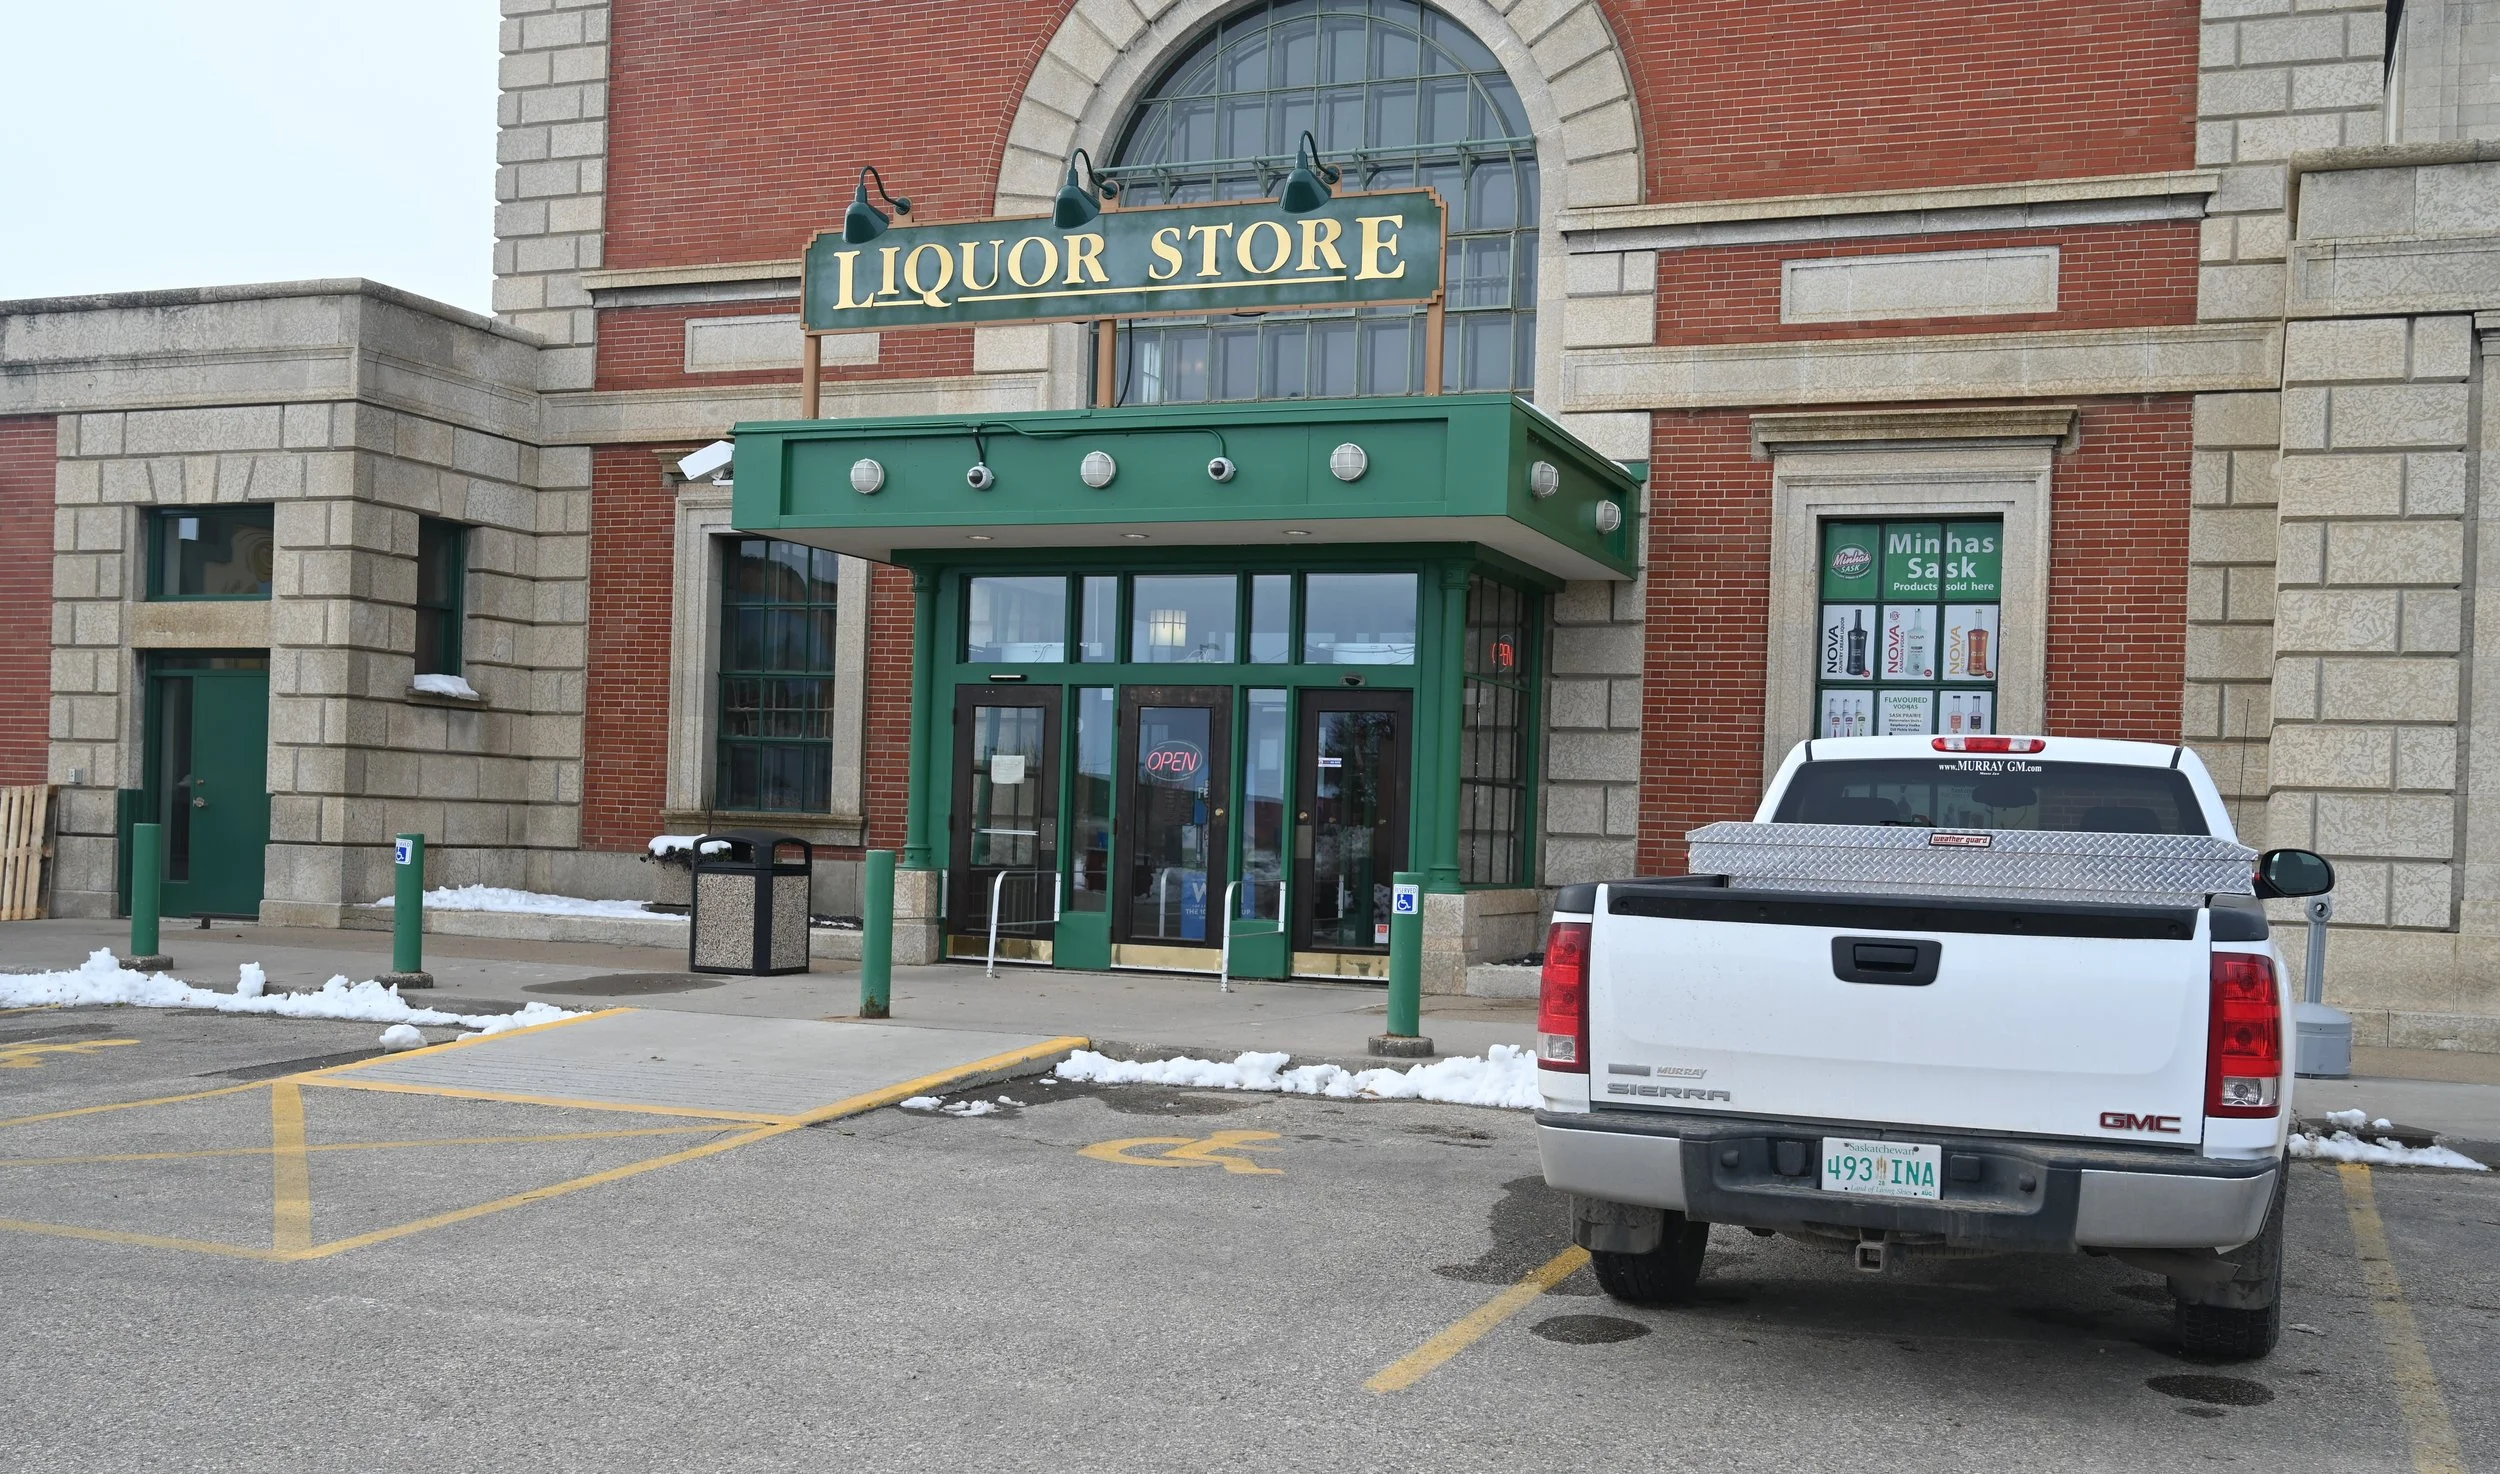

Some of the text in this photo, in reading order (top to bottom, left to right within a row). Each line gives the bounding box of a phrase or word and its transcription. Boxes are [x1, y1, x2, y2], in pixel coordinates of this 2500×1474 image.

[833, 214, 1406, 310] LIQUOR STORE
[1888, 532, 1995, 554] Minhas
[1833, 552, 1870, 566] Minhas
[1841, 565, 1860, 573] SASK
[1907, 556, 1977, 579] Sask
[1893, 581, 1995, 591] Products sold here
[1827, 625, 1839, 673] NOVA
[1888, 625, 1900, 673] NOVA
[1949, 626, 1961, 674] NOVA
[1147, 751, 1197, 771] OPEN
[1939, 760, 2042, 772] www.MURRAY GM.com
[1933, 834, 1988, 844] weather guard
[1657, 1066, 1708, 1077] MURRAY
[1607, 1082, 1731, 1102] SIERRA
[2099, 1112, 2182, 1134] GMC
[1848, 1142, 1915, 1156] Saskatchewan
[1827, 1155, 1935, 1188] 493 INA
